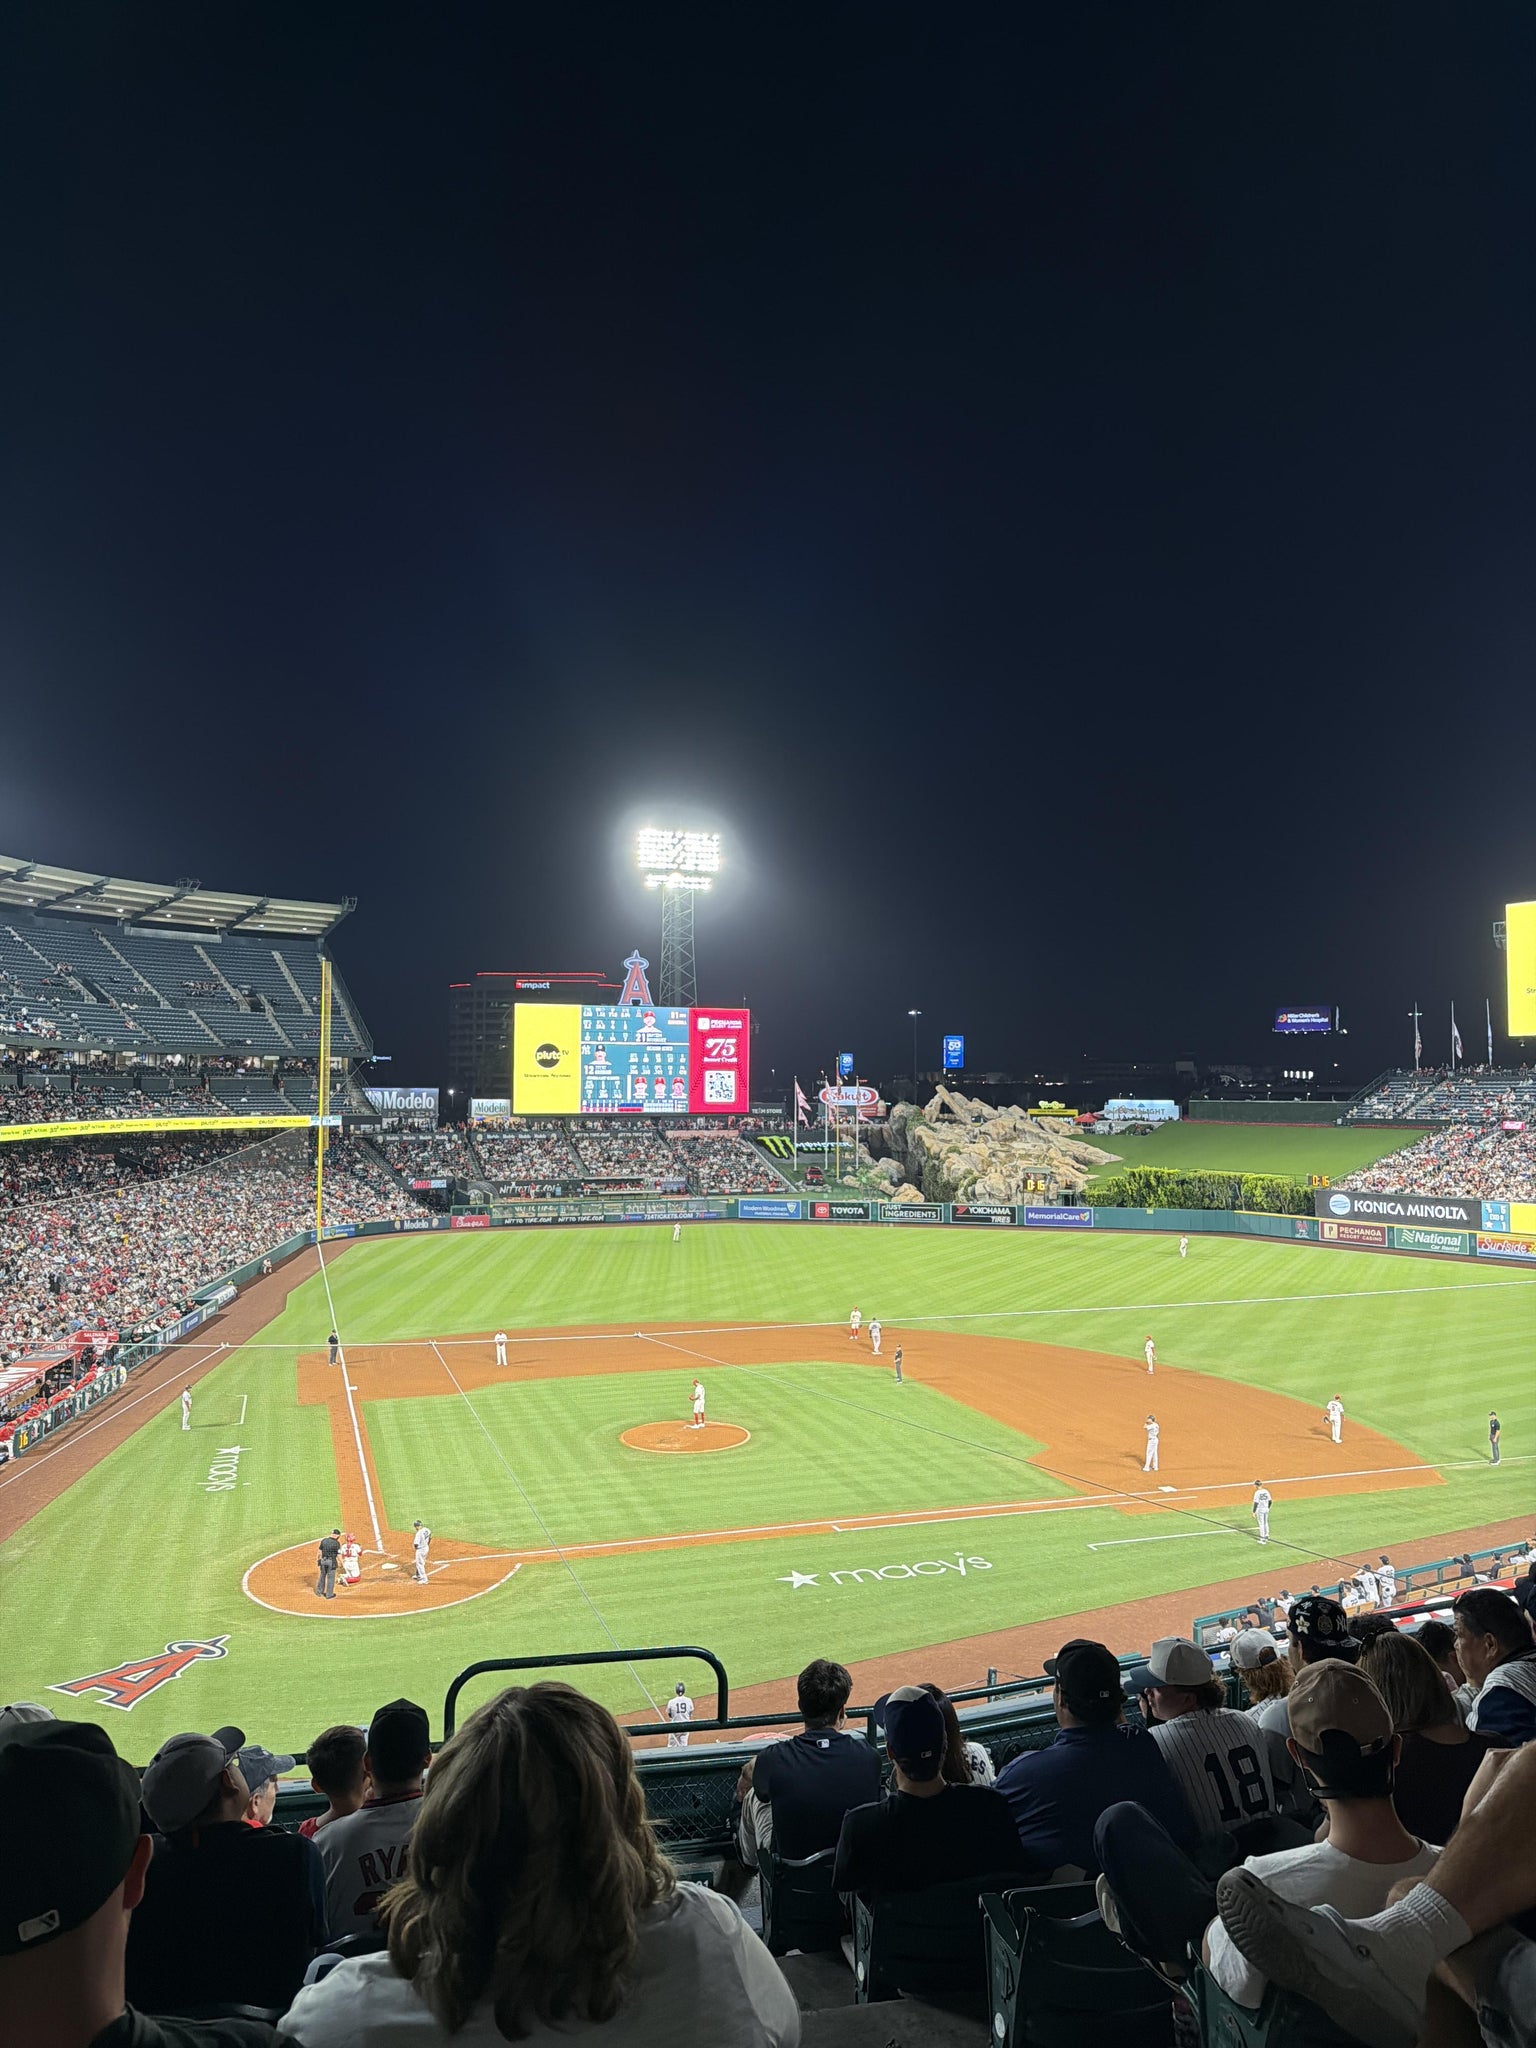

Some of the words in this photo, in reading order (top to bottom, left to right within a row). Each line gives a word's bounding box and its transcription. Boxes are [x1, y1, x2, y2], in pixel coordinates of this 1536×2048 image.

[522, 982, 550, 990] impact
[705, 1038, 737, 1056] $75
[536, 1050, 561, 1061] pluto
[584, 1065, 594, 1074] 12
[383, 1091, 434, 1109] Modelo
[475, 1103, 506, 1113] Modelo
[832, 1207, 864, 1215] TOYOTA
[885, 1210, 937, 1218] INGREDIENTS
[969, 1207, 1010, 1215] YOKOHAMA
[1354, 1200, 1404, 1215] KONICA
[1407, 1204, 1467, 1220] MINOLTA
[1028, 1211, 1079, 1220] MemorialCare
[404, 1220, 428, 1230] Modelo
[1340, 1227, 1381, 1236] PECHANGA
[1415, 1232, 1461, 1246] National
[1481, 1236, 1527, 1253] Surfside
[676, 1703, 687, 1713] 19
[1204, 1745, 1269, 1822] 18
